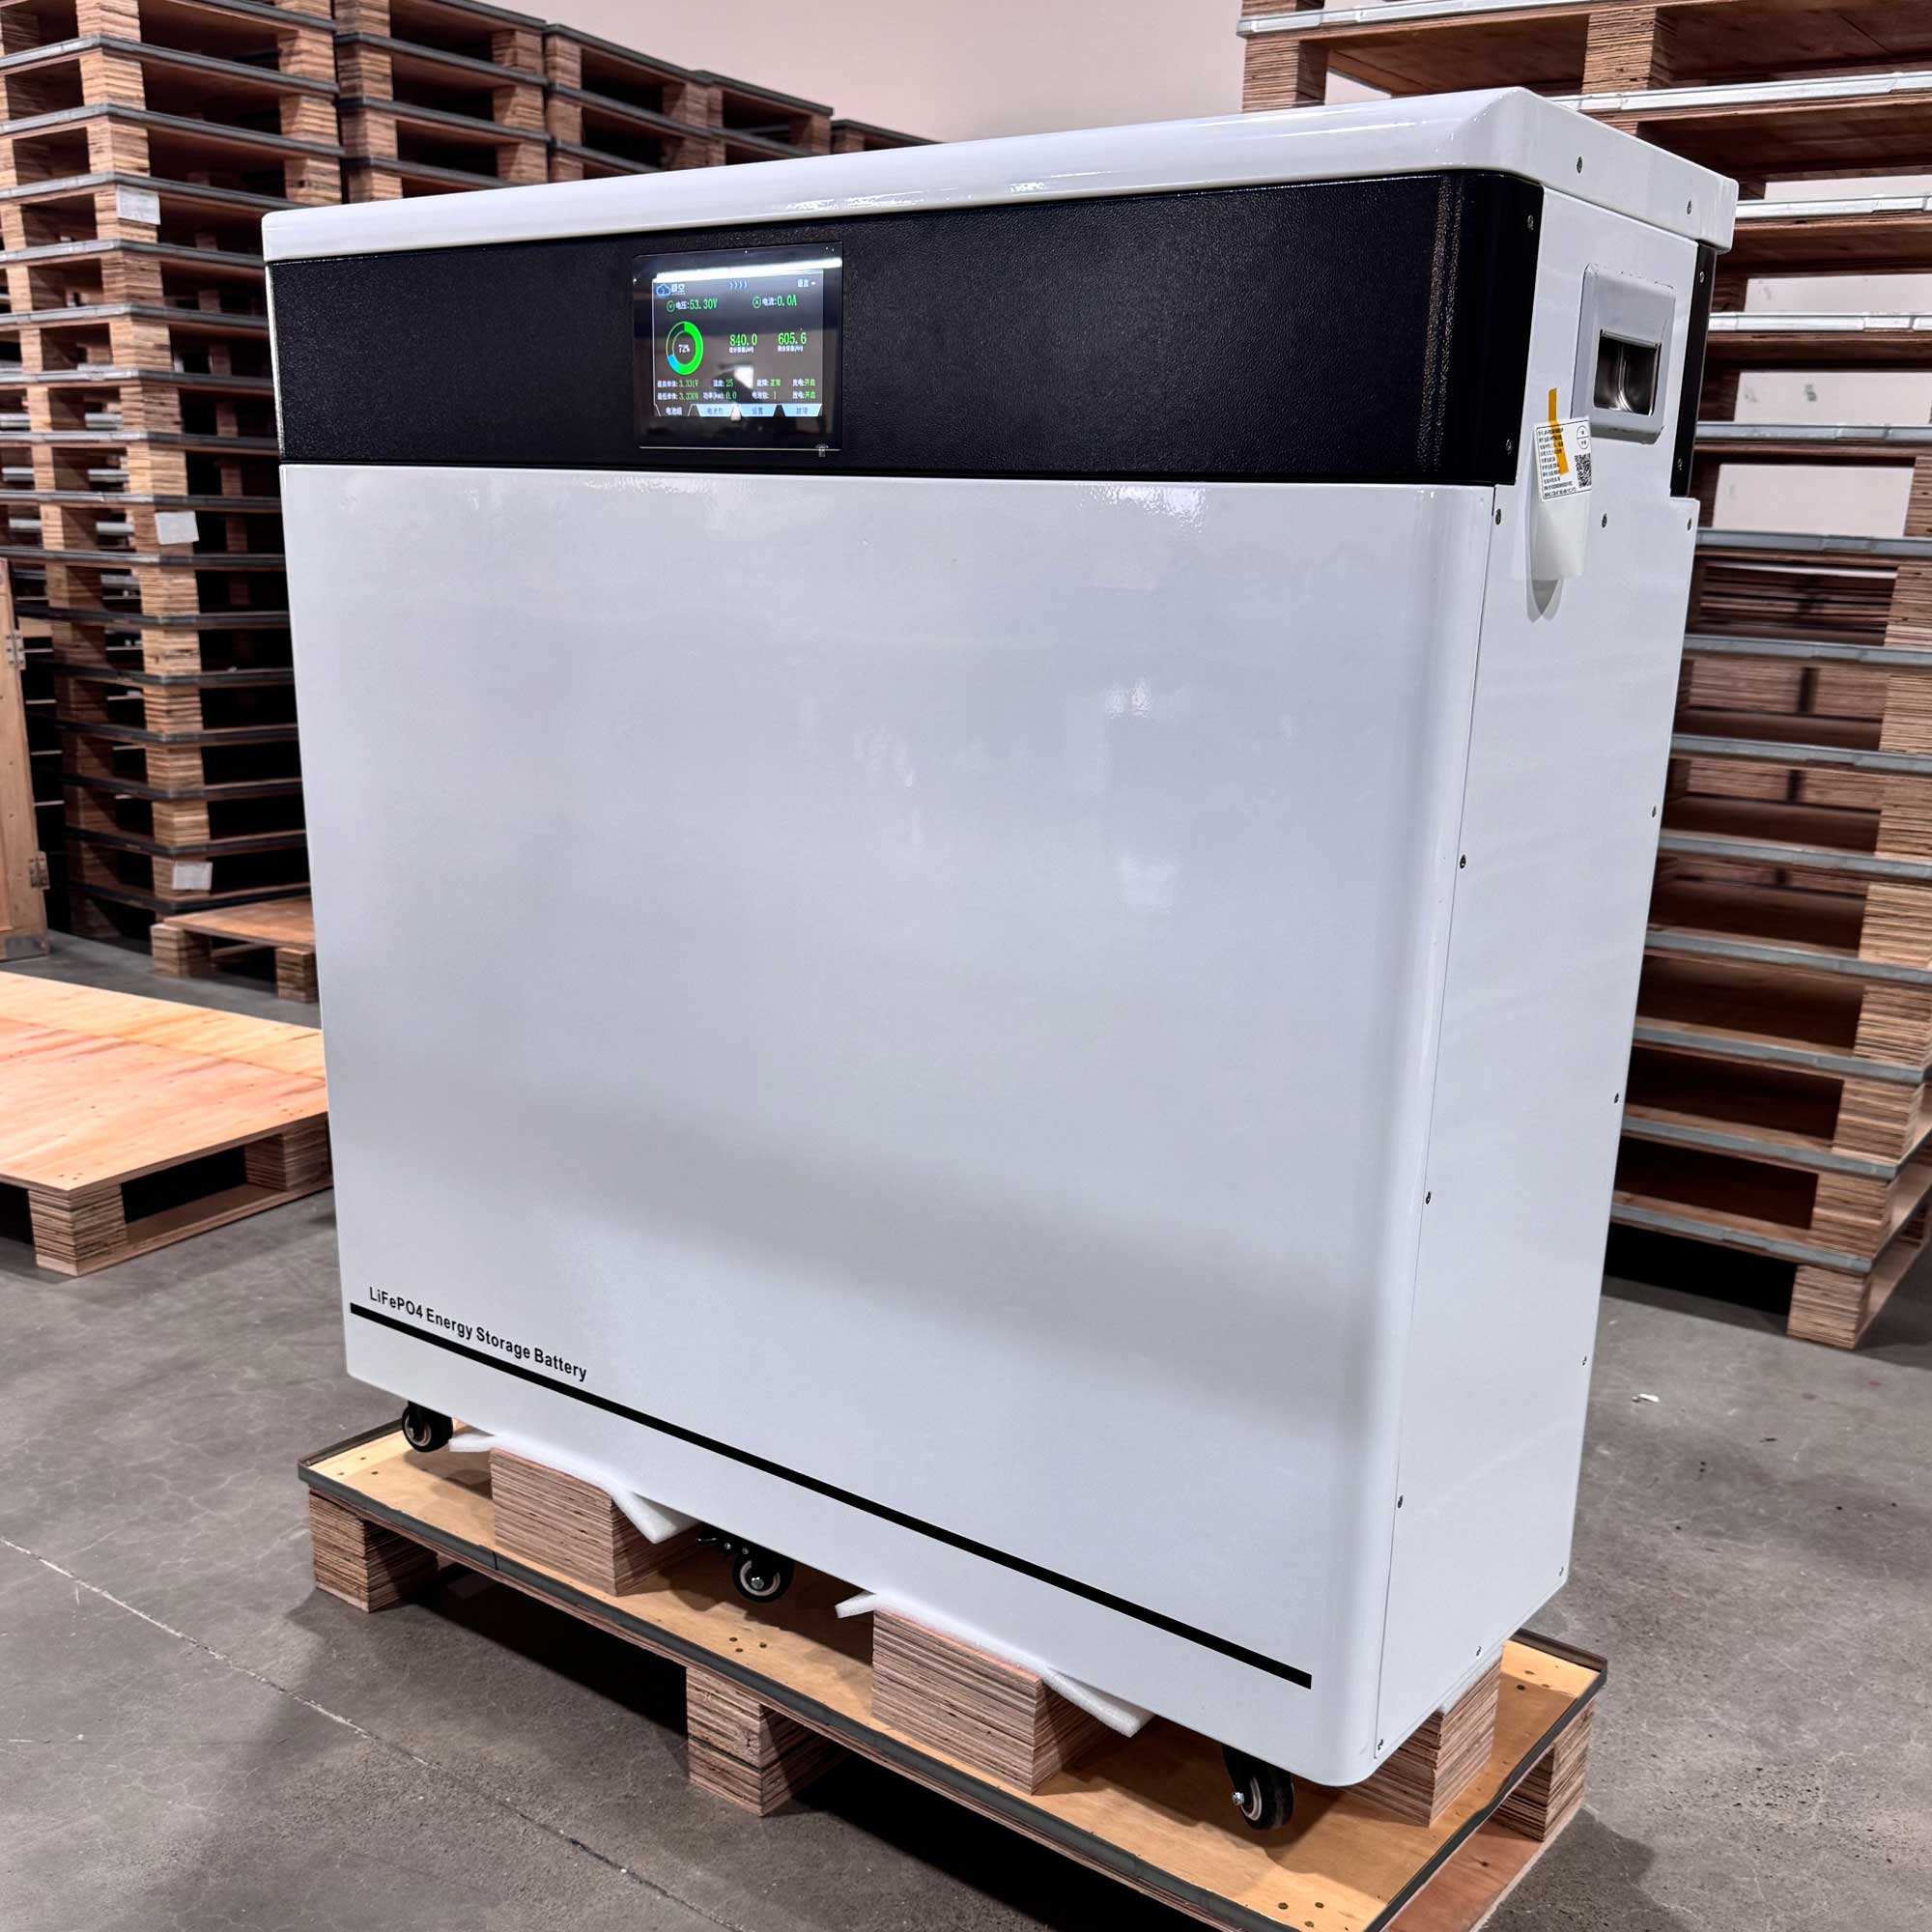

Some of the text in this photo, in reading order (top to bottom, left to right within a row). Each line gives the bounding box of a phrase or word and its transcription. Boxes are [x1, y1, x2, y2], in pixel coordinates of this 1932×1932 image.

[729, 333, 757, 346] 840.0
[778, 331, 808, 345] 605.6
[369, 1286, 587, 1382] LiFePO4 Energy Storage Battery
